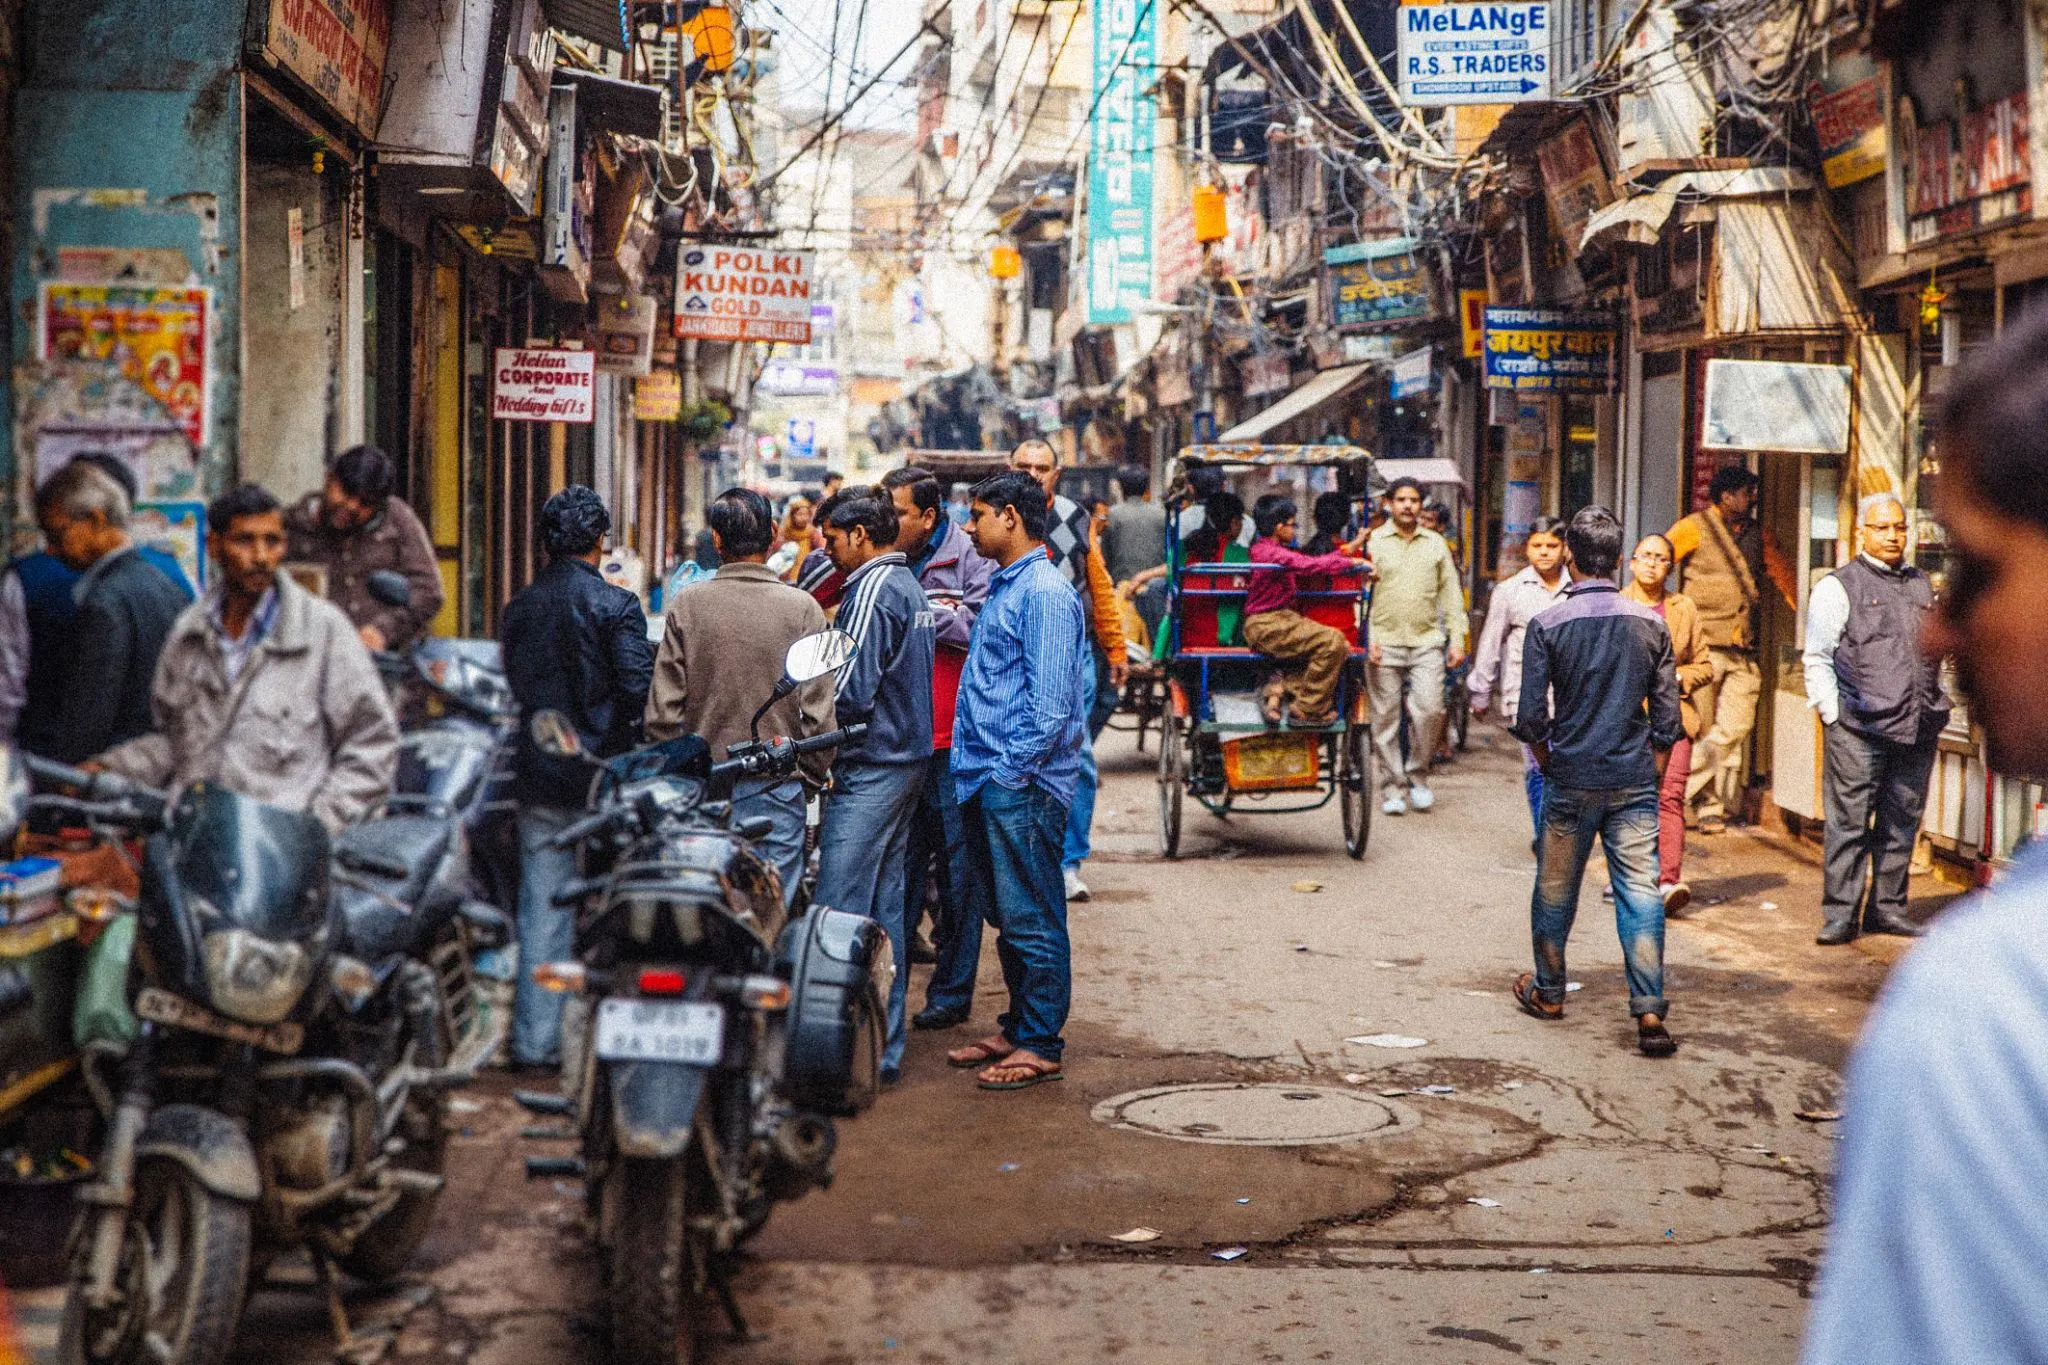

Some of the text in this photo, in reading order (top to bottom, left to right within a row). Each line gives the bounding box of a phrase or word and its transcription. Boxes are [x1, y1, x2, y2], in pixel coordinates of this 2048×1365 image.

[1408, 6, 1545, 36] MeLANgE
[1409, 54, 1546, 75] R.S. TRADERS
[714, 252, 801, 275] POLKI
[684, 272, 809, 298] KUNDAN
[711, 297, 761, 316] GOLD
[499, 369, 590, 387] CORPORATE
